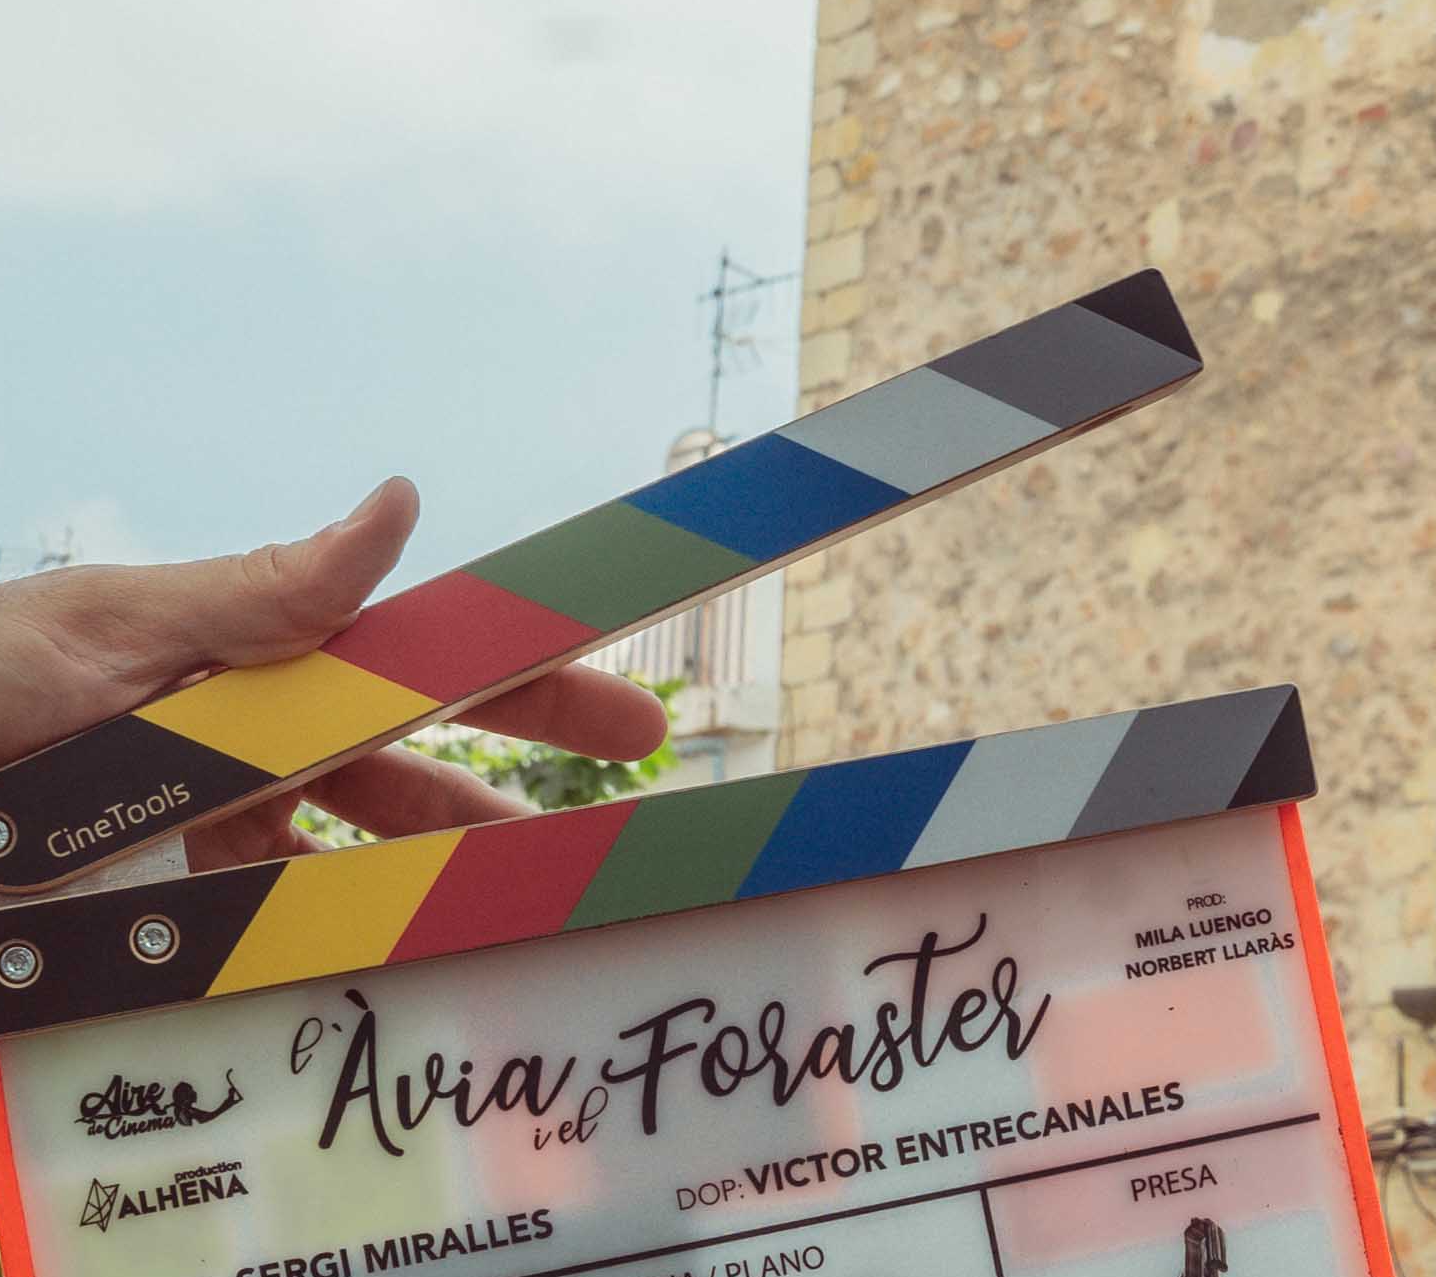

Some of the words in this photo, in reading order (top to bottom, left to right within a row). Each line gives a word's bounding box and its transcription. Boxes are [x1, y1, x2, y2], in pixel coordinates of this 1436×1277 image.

[46, 782, 191, 858] CineTools
[1186, 893, 1227, 911] PROD:
[1135, 925, 1185, 950] MILA
[1188, 908, 1273, 940] LUENGO
[1124, 947, 1217, 980] NORBERT
[1221, 932, 1296, 962] LLARÀS
[600, 912, 1052, 1136] Foraster
[77, 1074, 167, 1119] Aire
[104, 1115, 177, 1141] Cinema
[675, 1179, 746, 1213] DOP:
[743, 1140, 887, 1197] VICTOR
[895, 1081, 1185, 1168] ENTRECANALES
[174, 1160, 243, 1184] production
[1130, 1164, 1218, 1203] PRESA
[118, 1173, 250, 1220] ALHENA
[363, 1207, 554, 1274] MIRALLES
